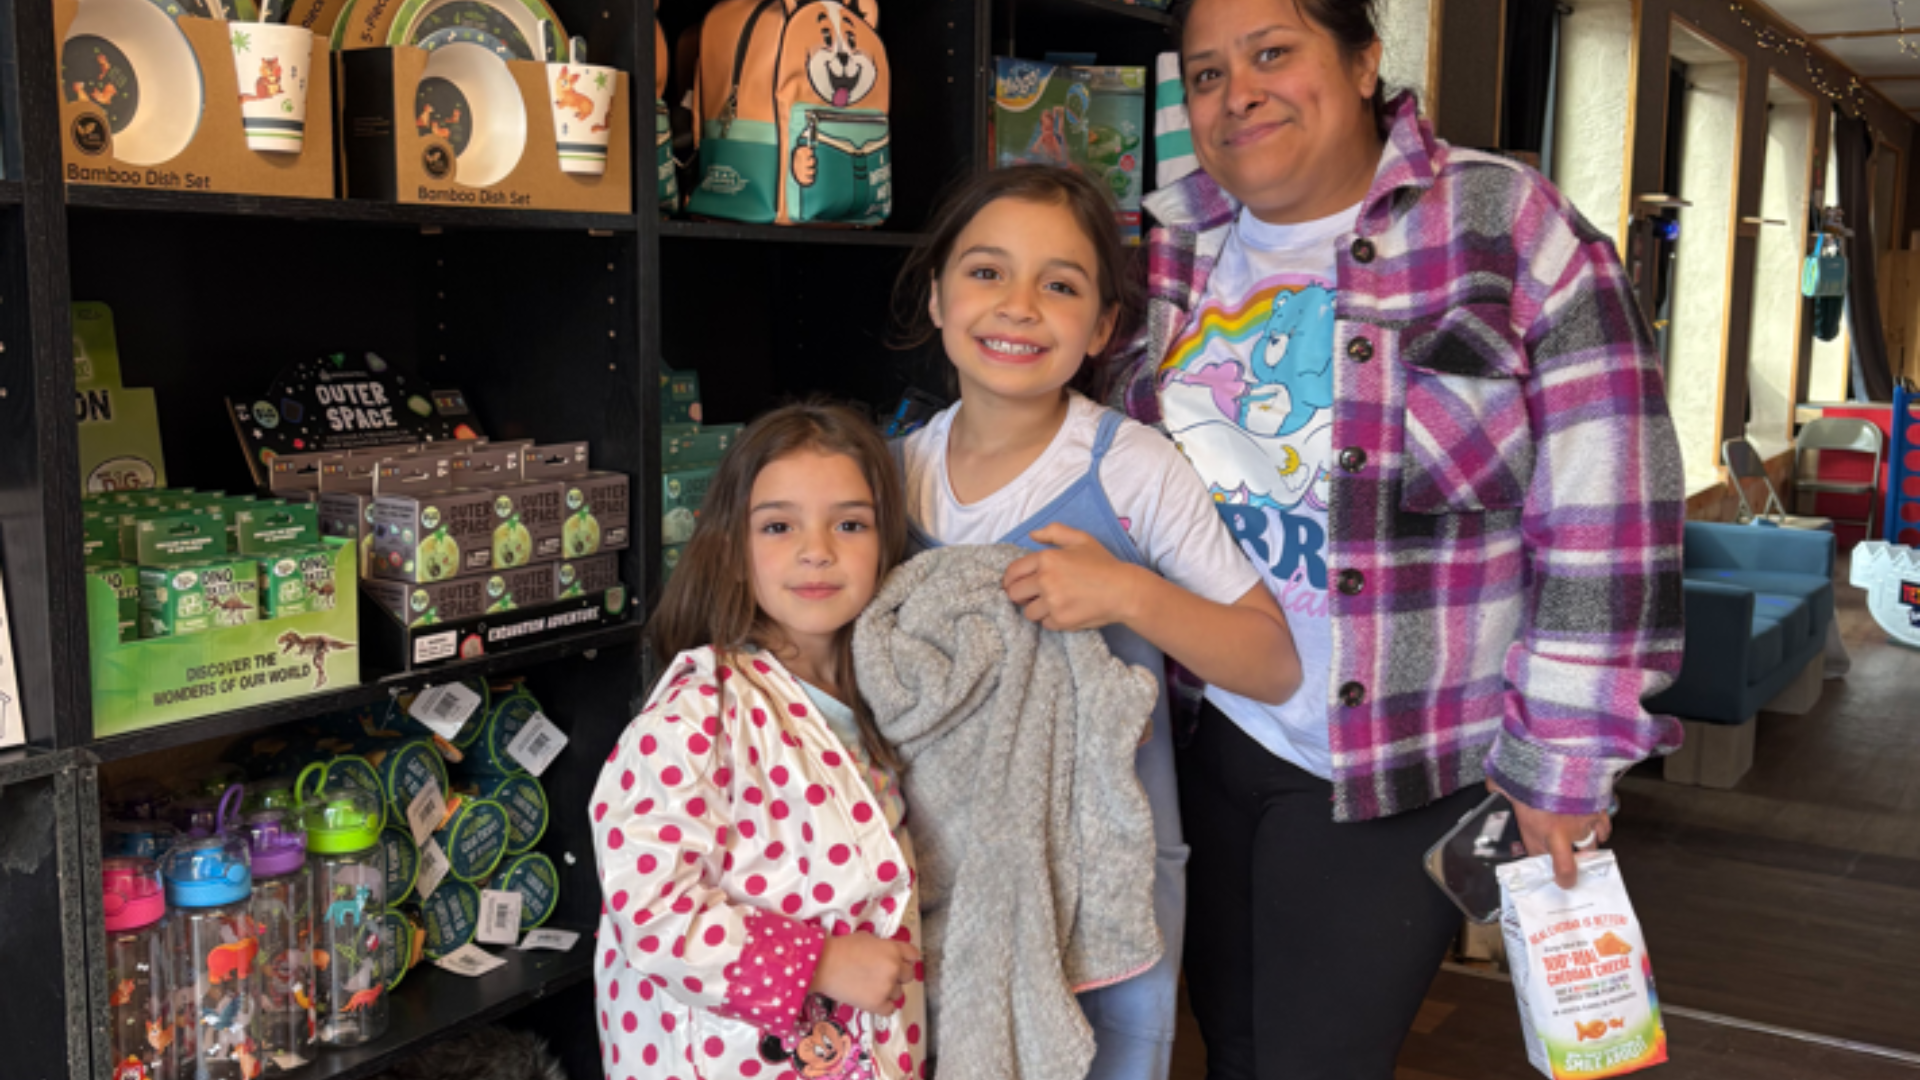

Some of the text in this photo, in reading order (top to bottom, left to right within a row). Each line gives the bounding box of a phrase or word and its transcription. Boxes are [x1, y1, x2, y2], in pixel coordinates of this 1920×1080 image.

[67, 163, 211, 188] Bamboo Dish Set
[418, 186, 531, 206] Bamboo Dish Set
[315, 380, 389, 407] OUTER
[326, 406, 398, 431] SPACE
[202, 567, 233, 585] DINO
[488, 606, 600, 642] EXCAVATION ADVENTURE
[186, 652, 277, 682] DISCOVER THE
[153, 663, 311, 706] WONDERS OF OUR WORLD
